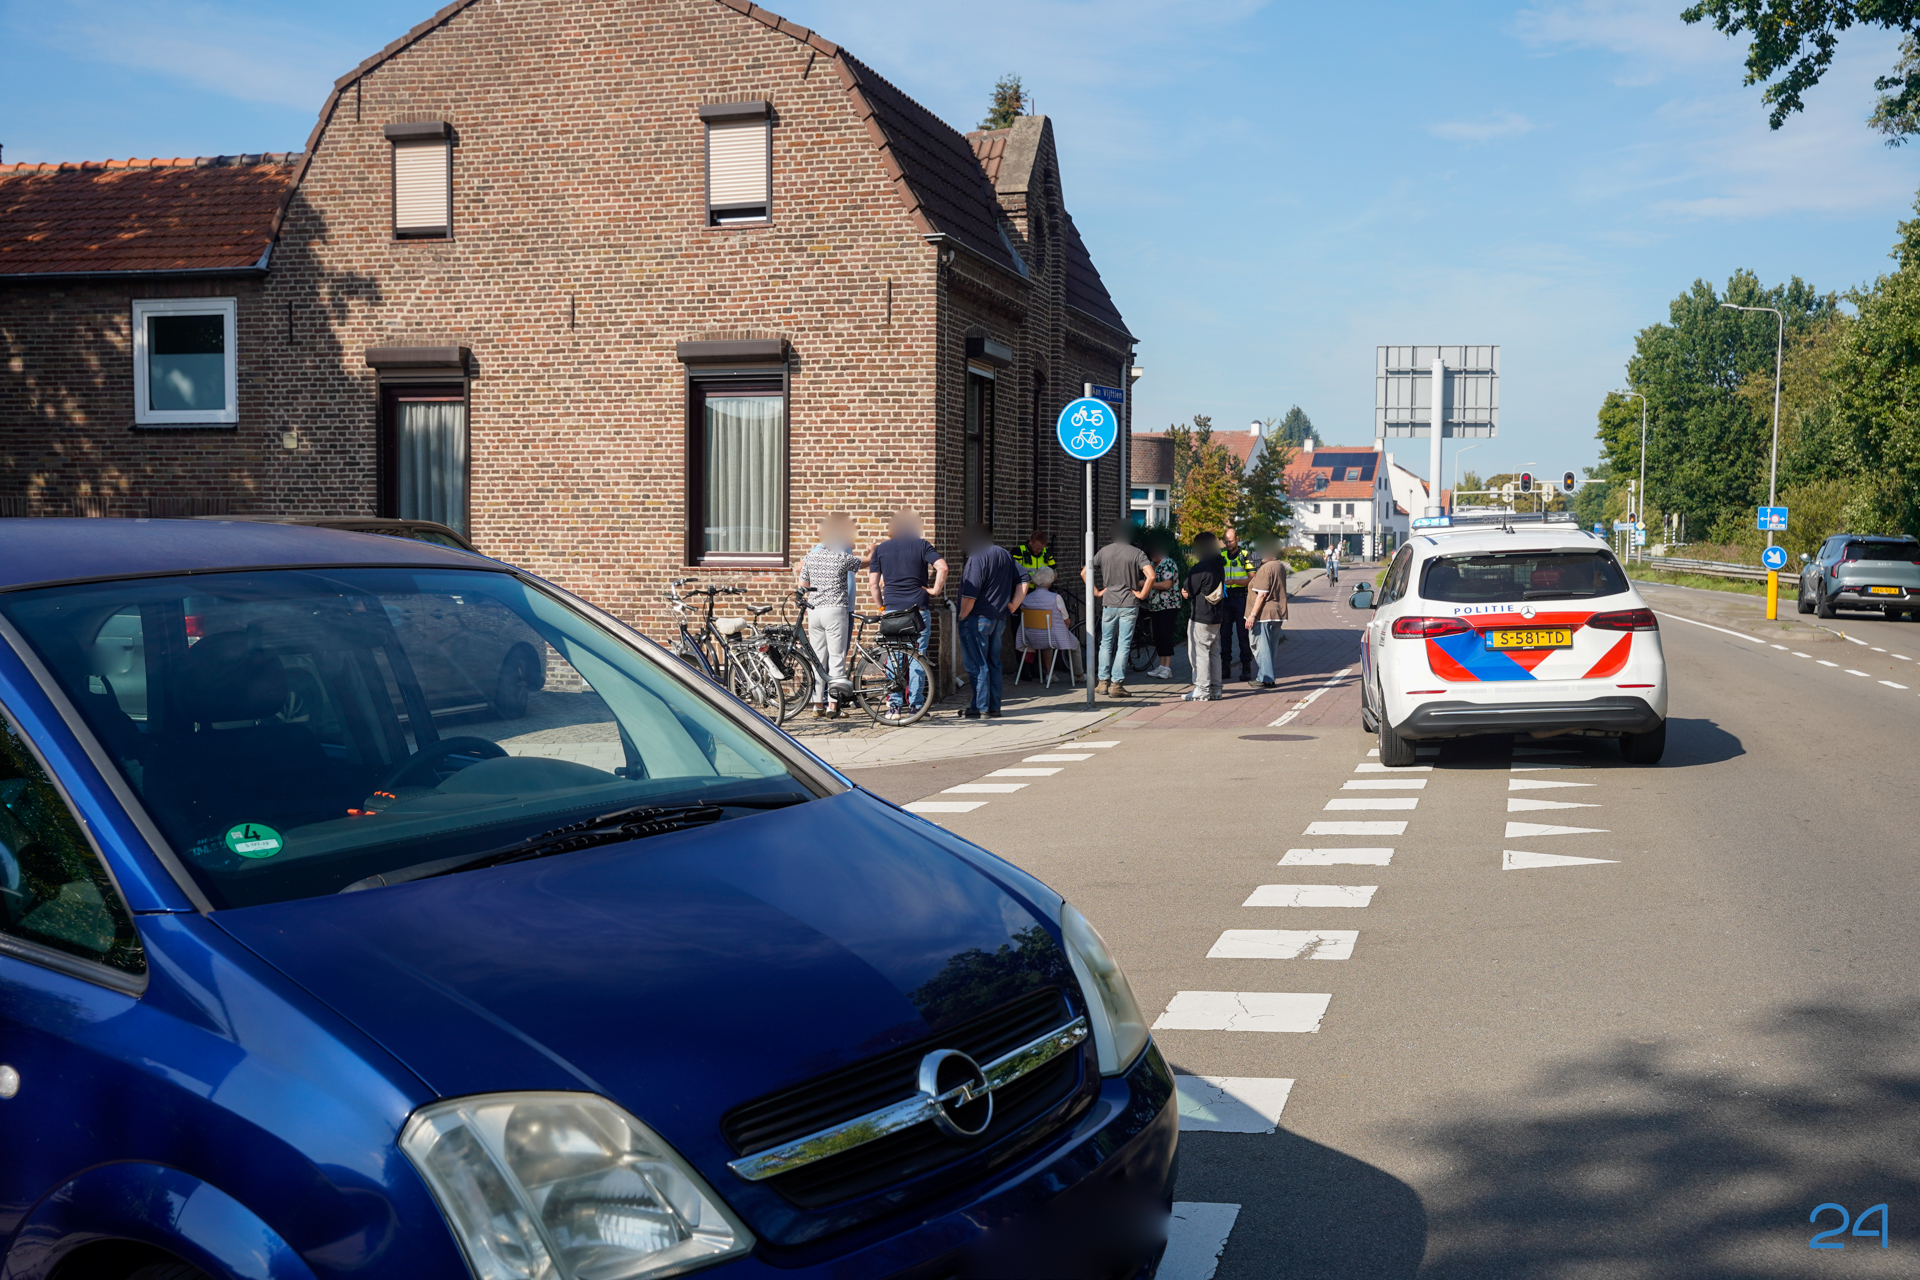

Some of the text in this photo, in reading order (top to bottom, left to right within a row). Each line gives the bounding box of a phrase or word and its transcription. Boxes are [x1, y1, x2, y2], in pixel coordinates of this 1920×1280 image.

[1454, 605, 1515, 615] POLITIE
[1500, 631, 1564, 645] S-581-TD
[243, 824, 261, 840] 4
